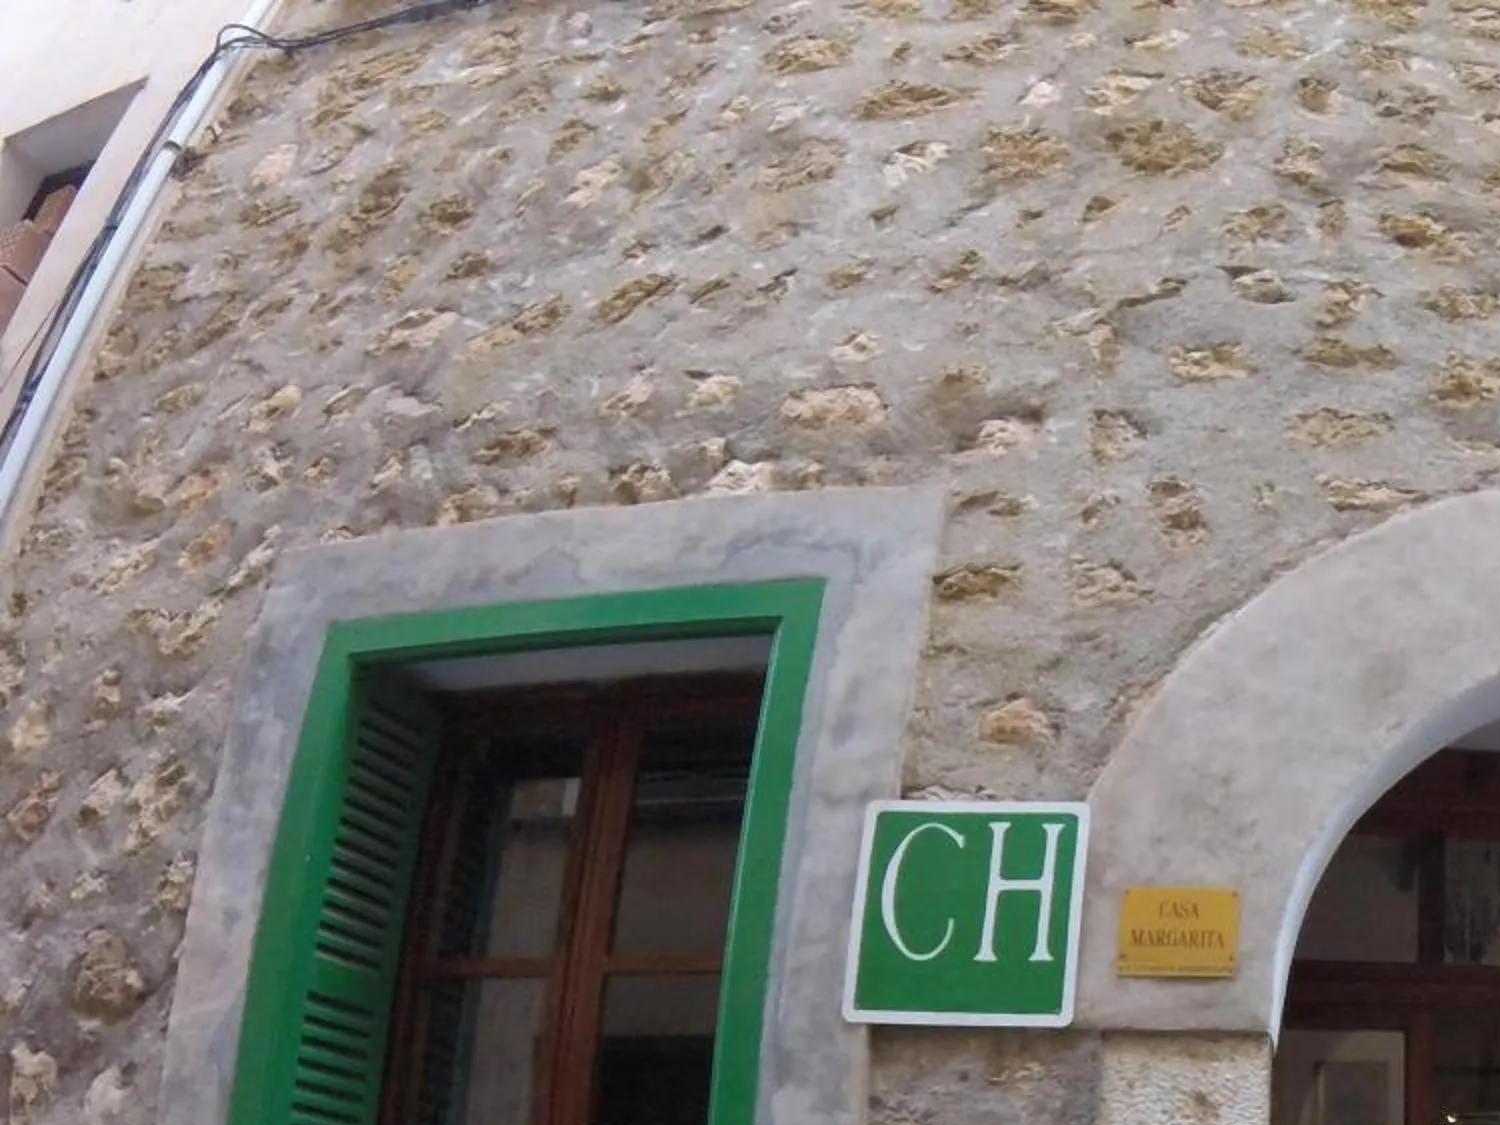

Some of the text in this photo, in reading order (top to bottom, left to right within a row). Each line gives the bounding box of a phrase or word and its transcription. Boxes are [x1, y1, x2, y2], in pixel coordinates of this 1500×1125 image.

[881, 821, 1067, 962] CH
[1158, 900, 1200, 919] CASA
[1129, 928, 1225, 949] MARGARITA
